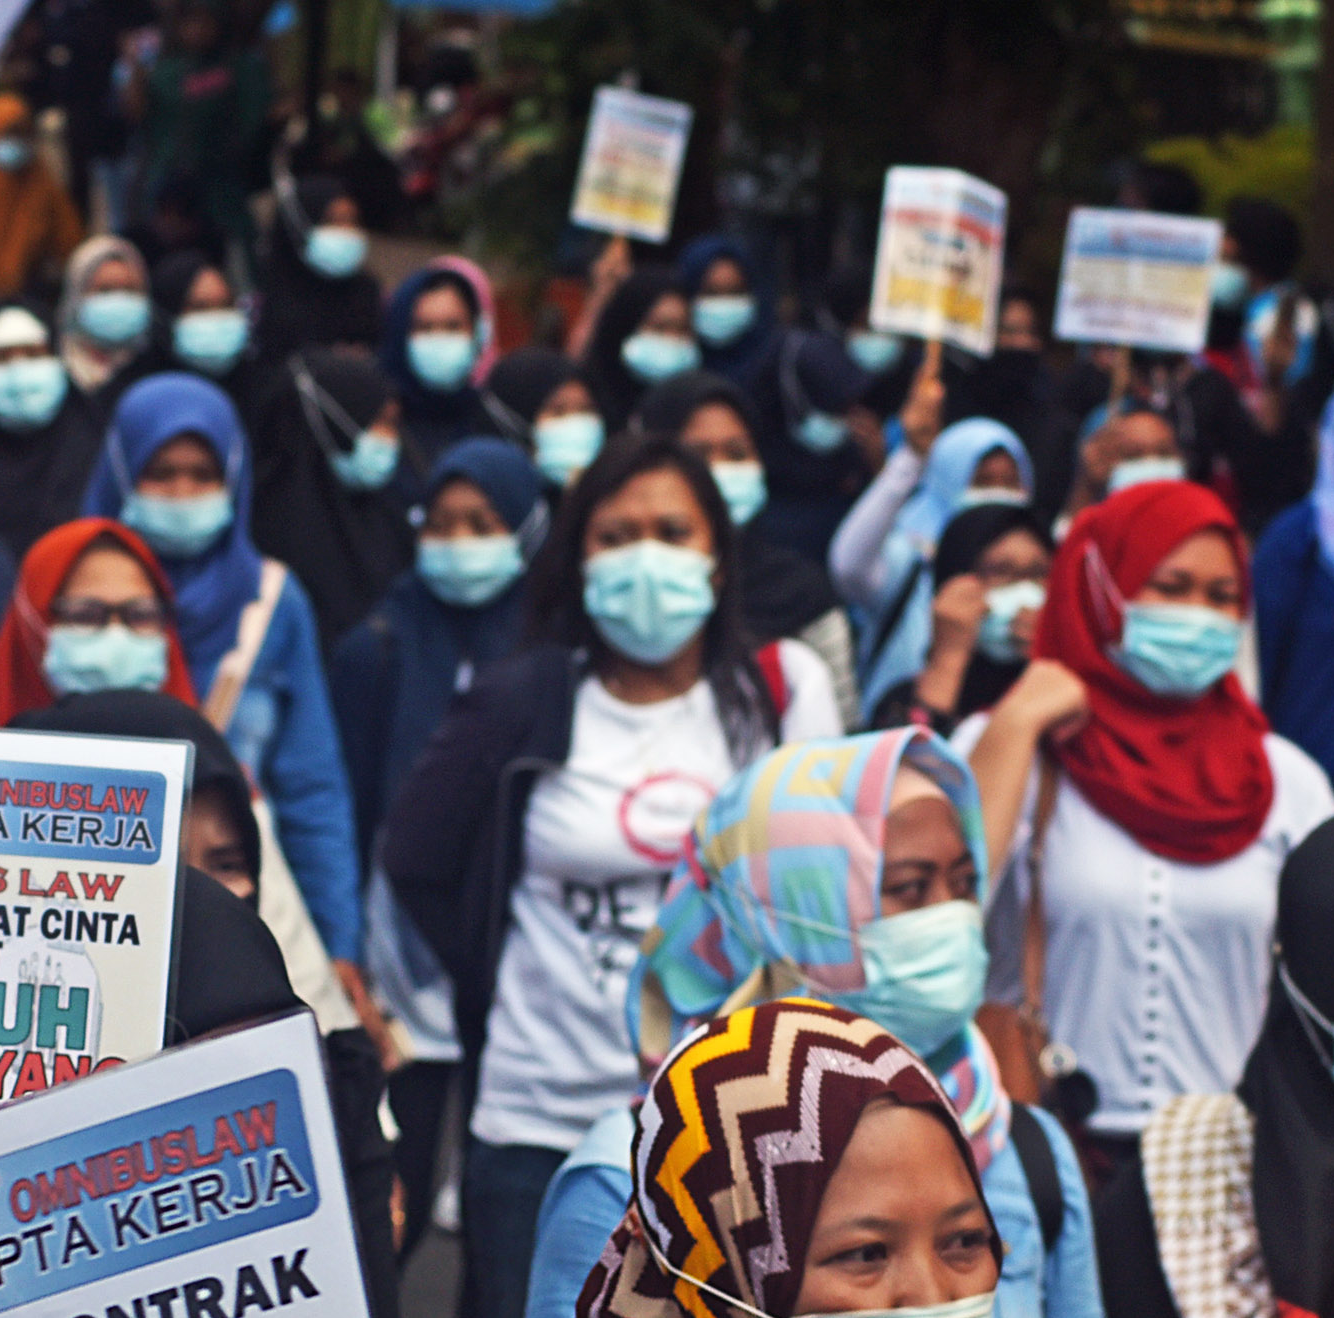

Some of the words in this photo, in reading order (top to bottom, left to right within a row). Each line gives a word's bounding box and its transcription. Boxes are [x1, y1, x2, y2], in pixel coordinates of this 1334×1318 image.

[22, 812, 155, 851] KERJA
[20, 868, 125, 901] LAW
[41, 909, 140, 945] CINTA
[9, 1102, 278, 1222] OMNIBUSLAW
[110, 1153, 308, 1248] KERJA
